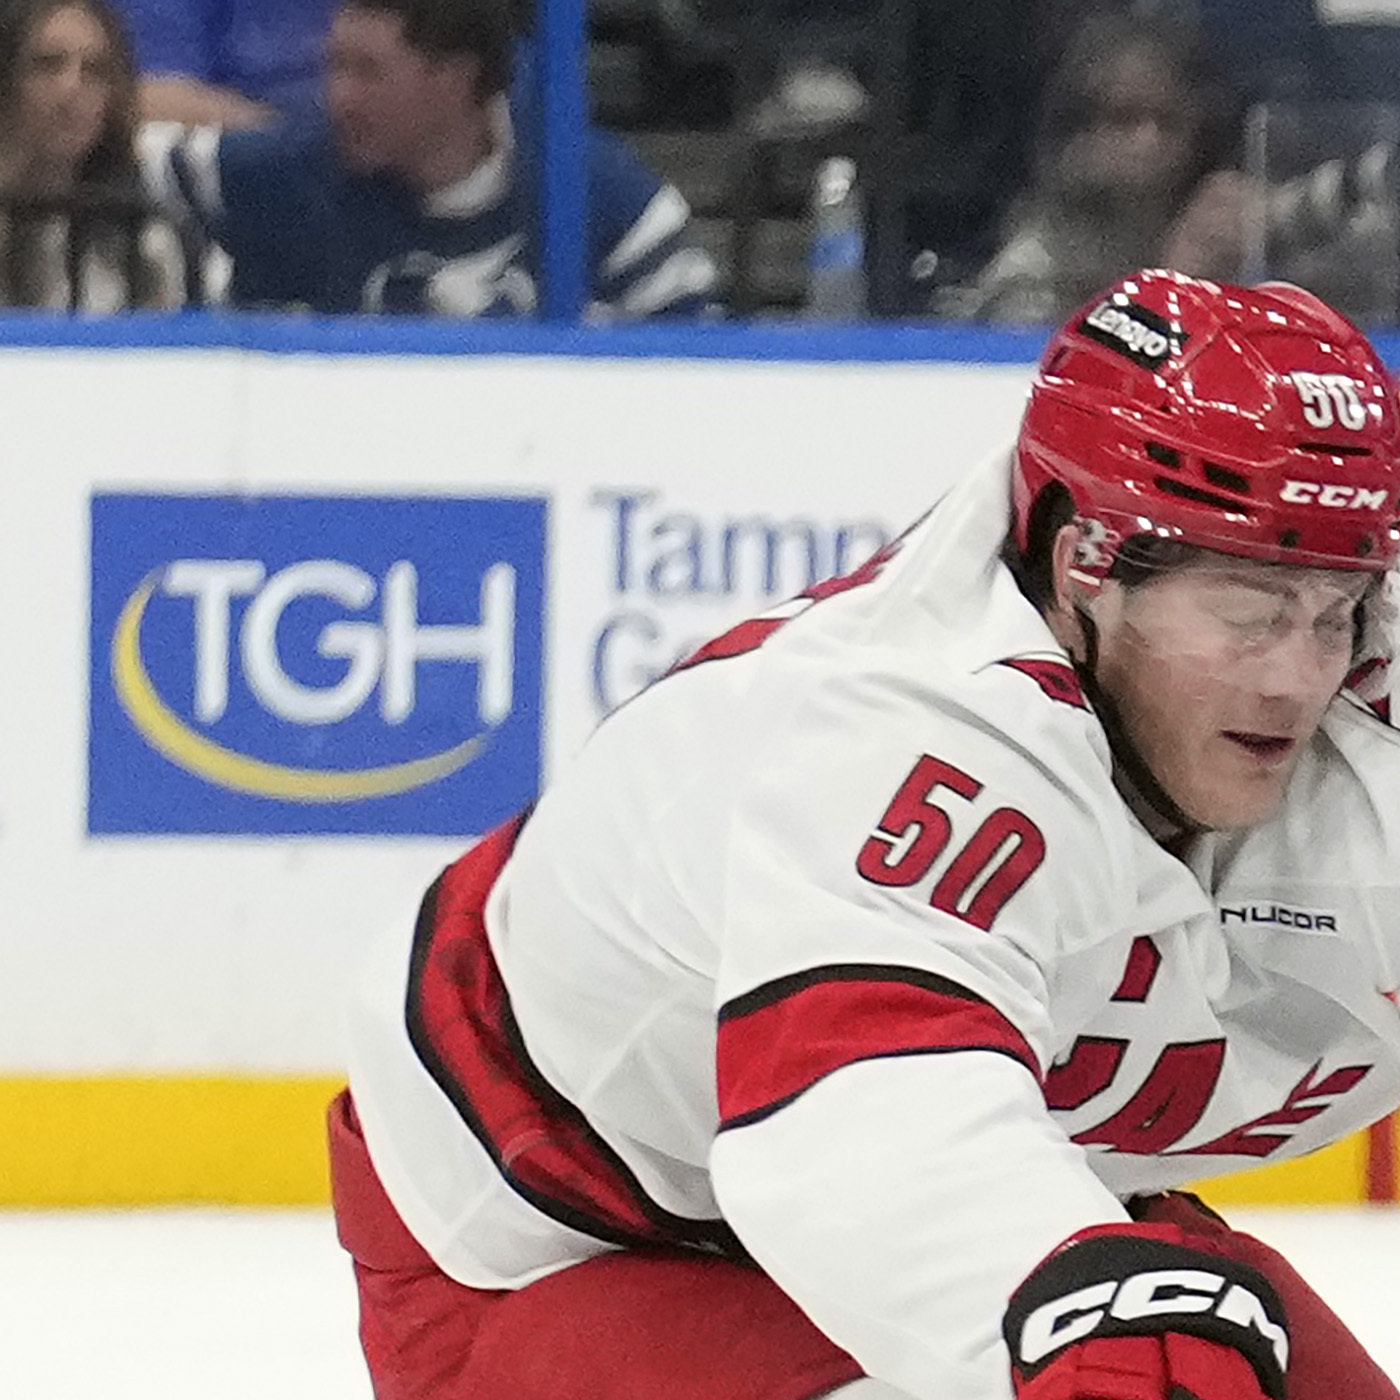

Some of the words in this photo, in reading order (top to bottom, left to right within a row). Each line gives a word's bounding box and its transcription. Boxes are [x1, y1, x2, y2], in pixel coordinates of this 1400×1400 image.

[1086, 300, 1169, 357] Lenovo
[1290, 371, 1367, 432] 50
[1279, 479, 1389, 511] CCM
[591, 489, 900, 605] Tamp
[163, 558, 518, 726] TGH
[855, 753, 1047, 933] 50
[1219, 905, 1338, 933] NUCOR
[1019, 1269, 1291, 1373] CCM
